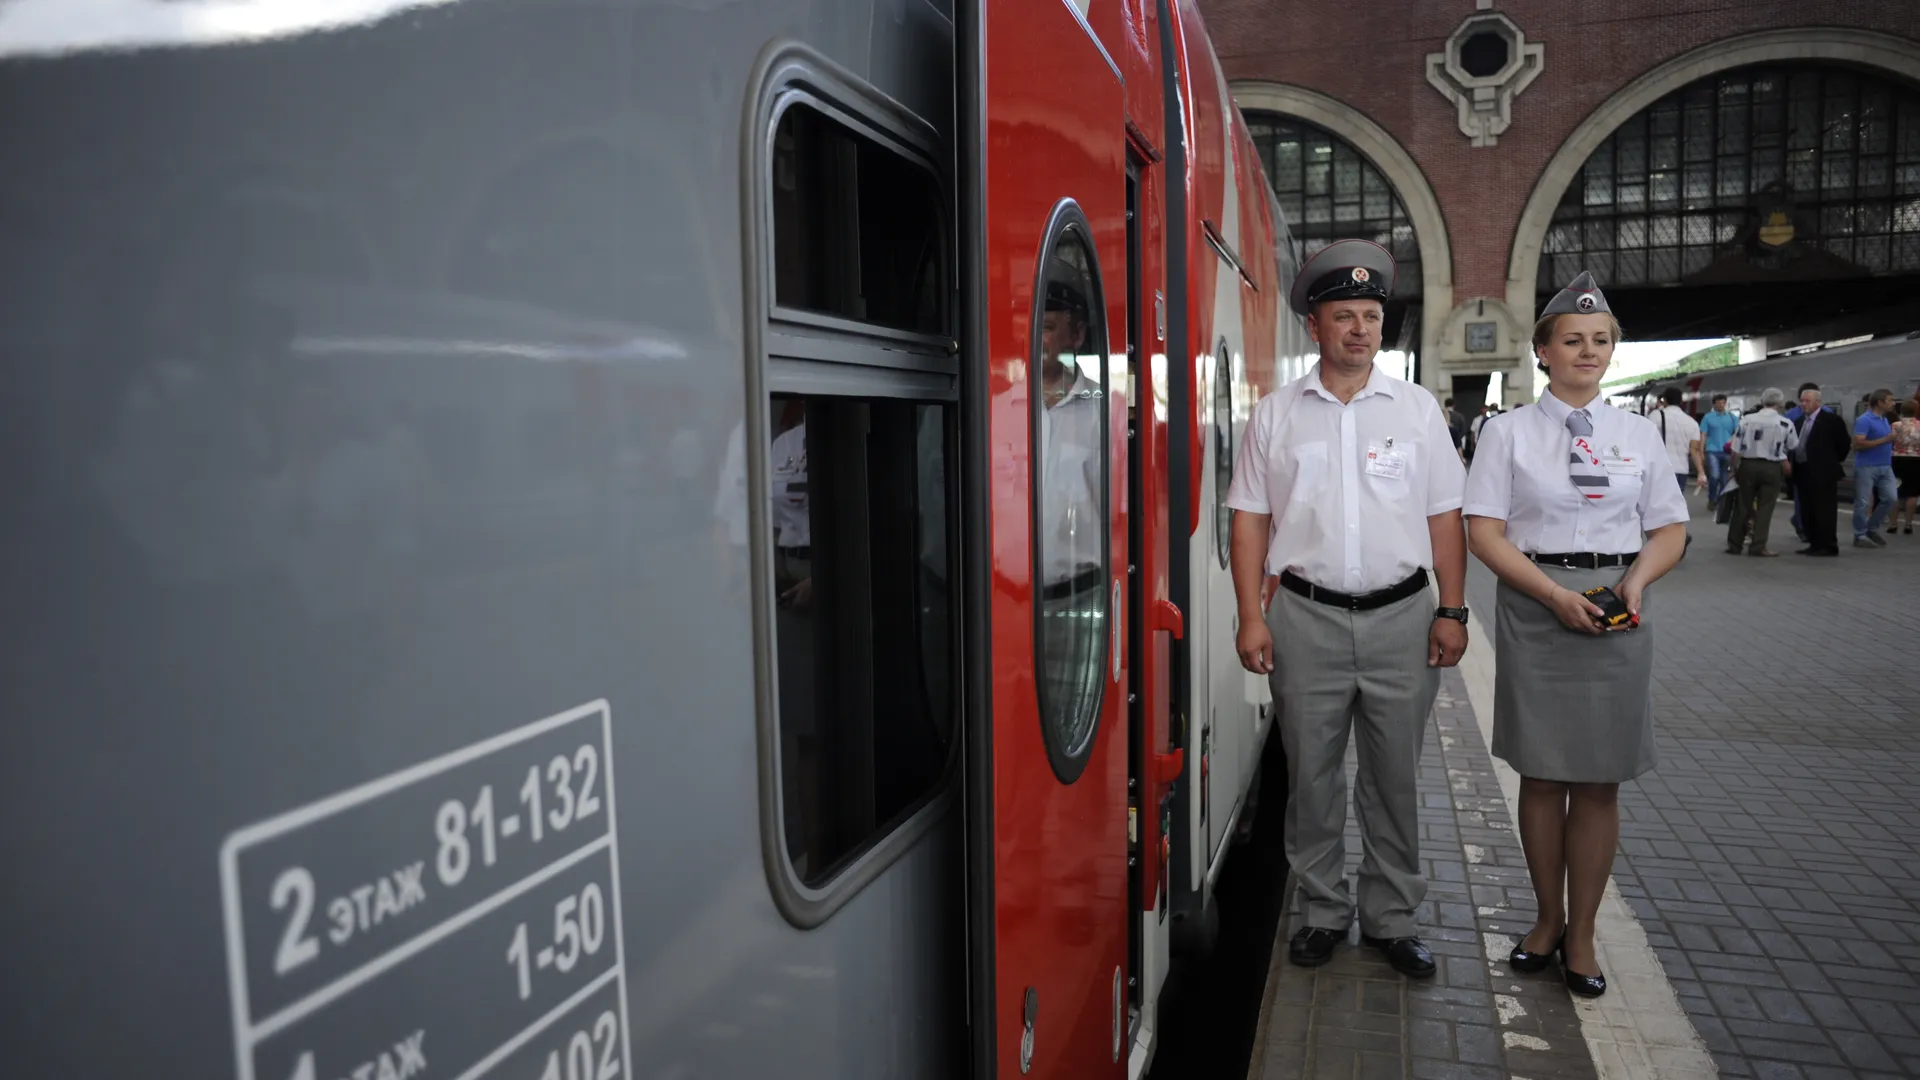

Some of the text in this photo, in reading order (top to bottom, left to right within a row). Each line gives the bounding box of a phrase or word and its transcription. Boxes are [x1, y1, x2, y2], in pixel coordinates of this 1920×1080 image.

[270, 744, 600, 976] 2 ЭТАЖ 81-132
[507, 882, 604, 1001] 1-50
